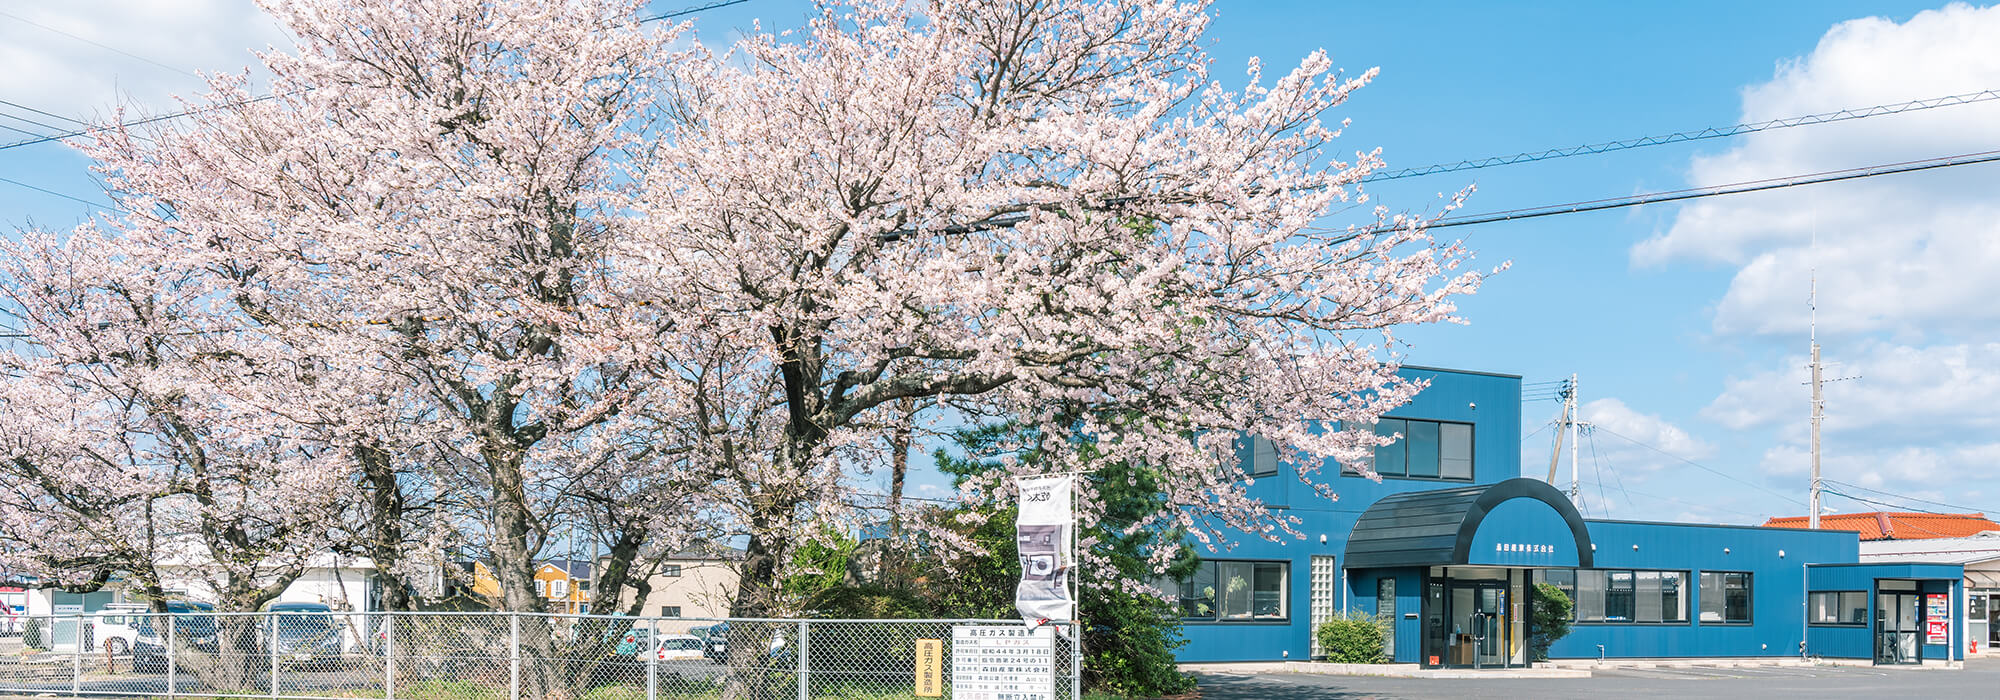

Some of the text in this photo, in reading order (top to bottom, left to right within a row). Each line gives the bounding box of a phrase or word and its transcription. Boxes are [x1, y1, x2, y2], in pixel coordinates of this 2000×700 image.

[923, 642, 933, 693] 高圧ガス製造所
